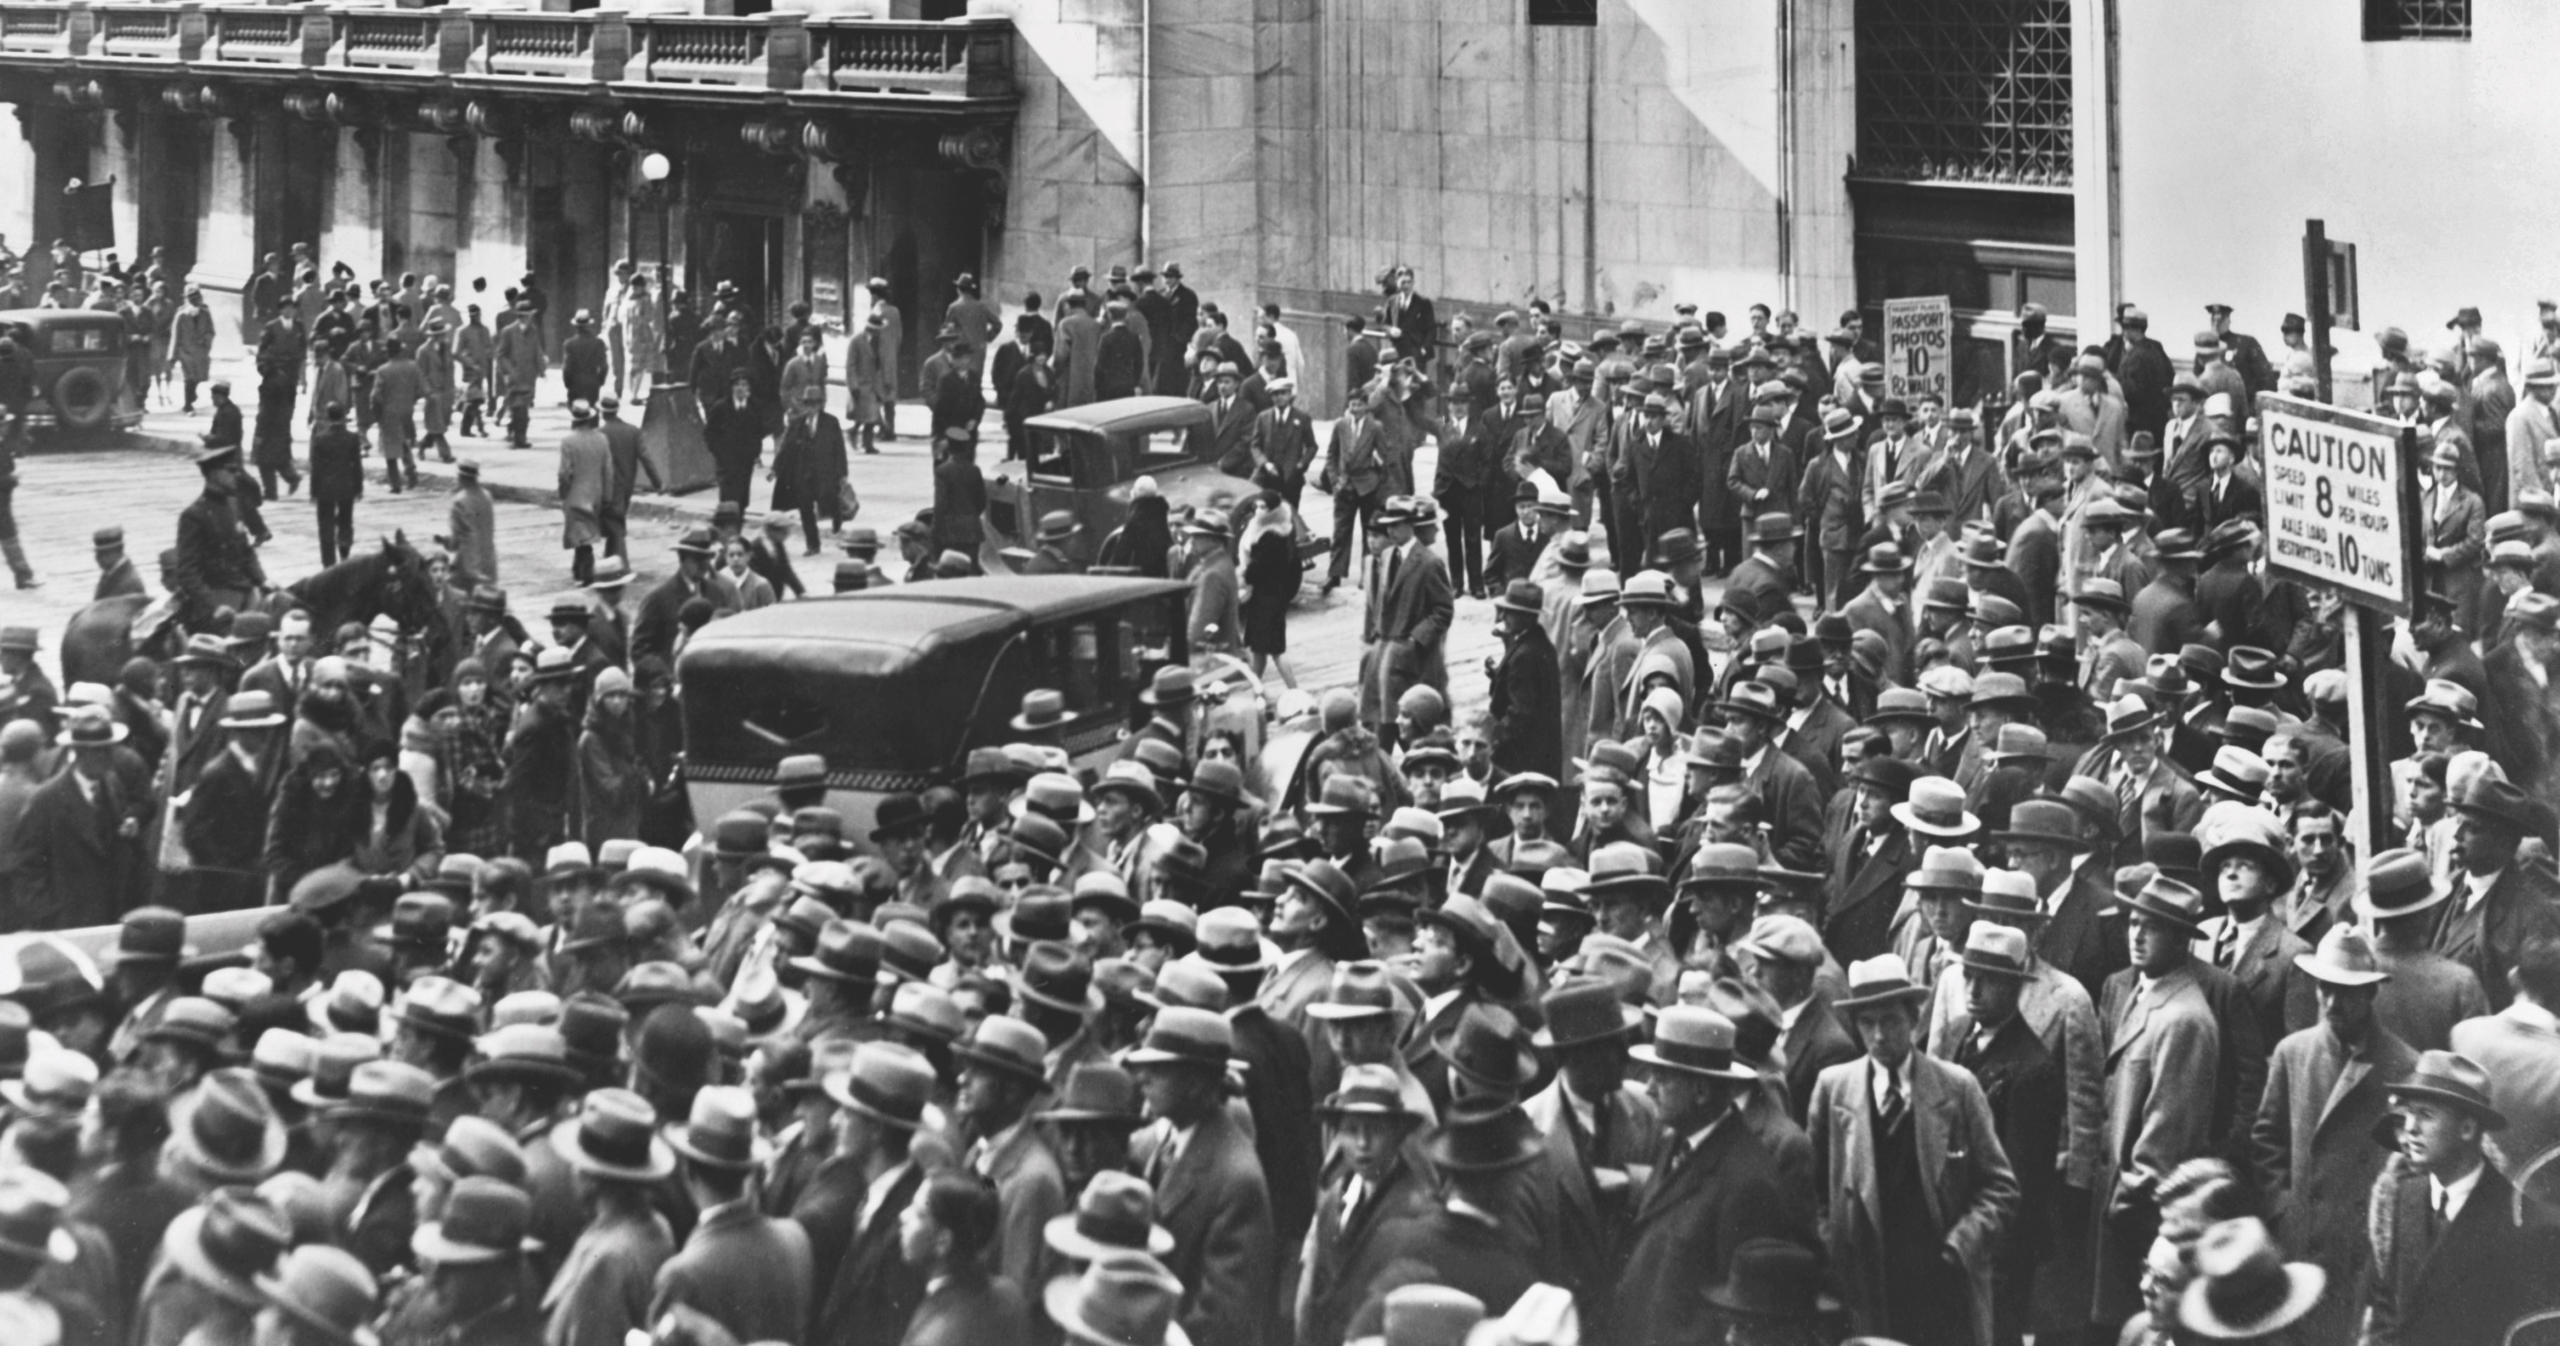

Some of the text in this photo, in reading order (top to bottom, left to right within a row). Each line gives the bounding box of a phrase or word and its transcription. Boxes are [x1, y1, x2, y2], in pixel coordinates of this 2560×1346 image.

[1891, 311, 1944, 329] PASSPORT
[1891, 329, 1945, 354] PHOTOS
[1907, 346, 1929, 376] 10
[1908, 377, 1932, 396] WALL
[2271, 422, 2386, 482] CAUTION
[2273, 464, 2306, 487] SPEED
[2274, 487, 2305, 510] LIMIT
[2316, 475, 2334, 519] 8
[2347, 484, 2381, 508] MILES
[2281, 516, 2328, 544] AXLE LOAD
[2338, 505, 2389, 534] PER HOUR
[2276, 531, 2393, 587] RESTRICTED TO 10 TONS
